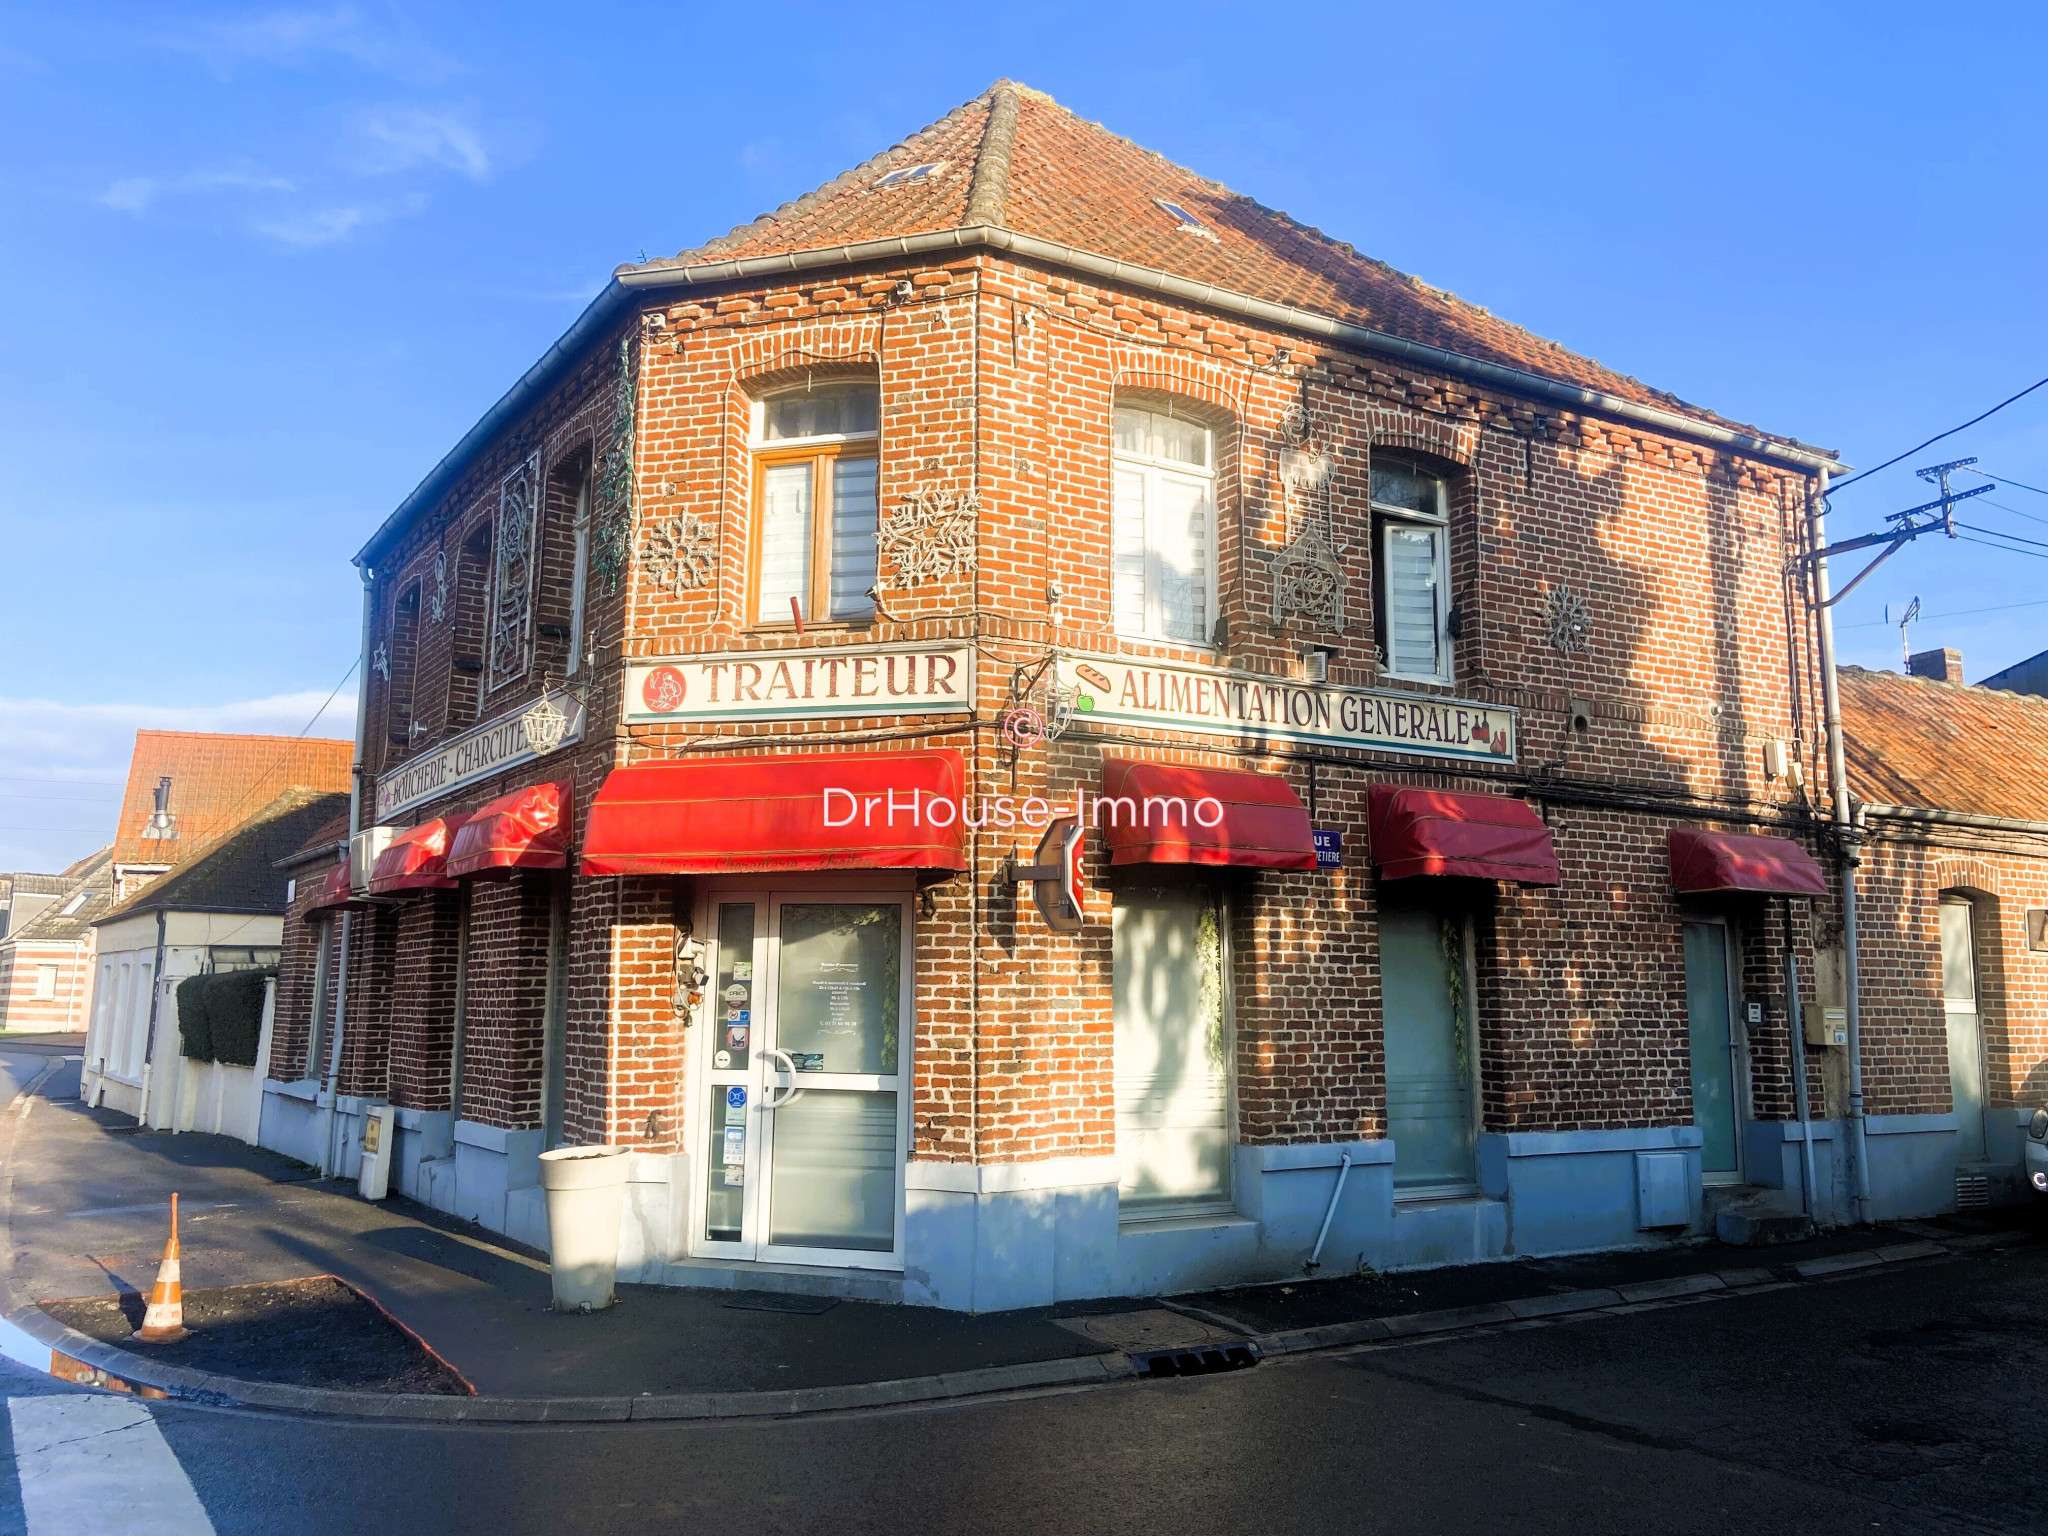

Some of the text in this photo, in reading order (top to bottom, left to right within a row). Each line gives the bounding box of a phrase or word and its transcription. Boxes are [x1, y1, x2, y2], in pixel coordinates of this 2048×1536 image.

[702, 654, 957, 702] TRAITEUR
[1119, 669, 1470, 745] ALIMENTATION GENERALE
[393, 755, 447, 806] BOUCHERIE
[456, 713, 545, 776] CHARCUTE
[1313, 835, 1331, 847] UE
